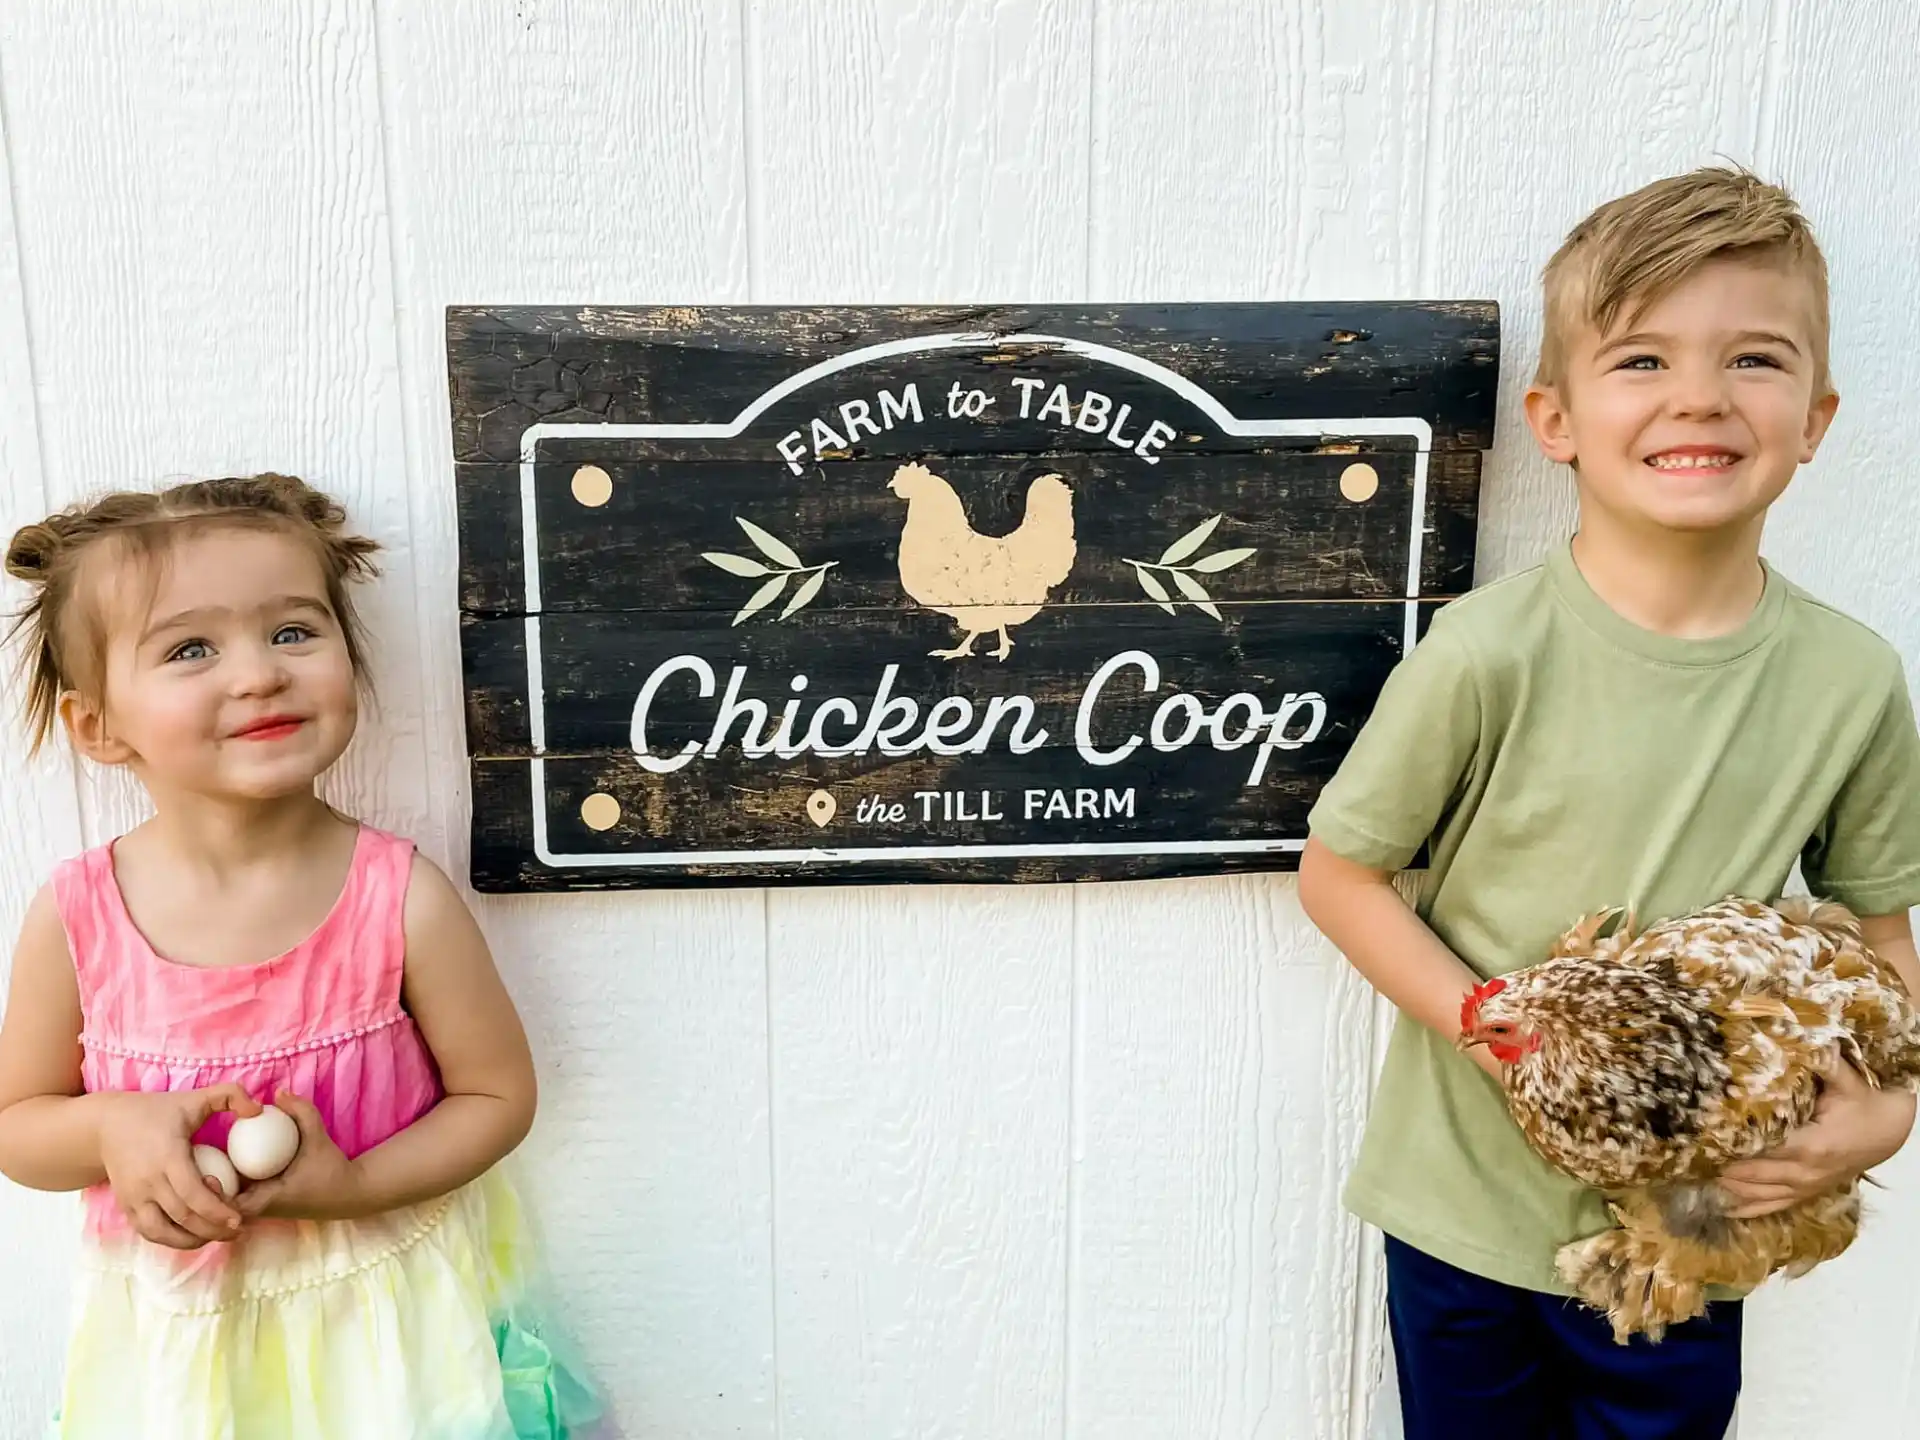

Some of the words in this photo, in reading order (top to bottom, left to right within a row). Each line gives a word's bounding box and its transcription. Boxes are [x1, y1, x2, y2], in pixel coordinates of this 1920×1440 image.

[776, 382, 925, 477] FARM
[946, 380, 996, 419] to
[1011, 377, 1177, 465] TABLE
[629, 654, 1049, 774] Chicken
[1074, 650, 1327, 786] Coop
[855, 792, 907, 824] the
[914, 790, 1004, 823] TILL
[1022, 787, 1137, 821] FARM
